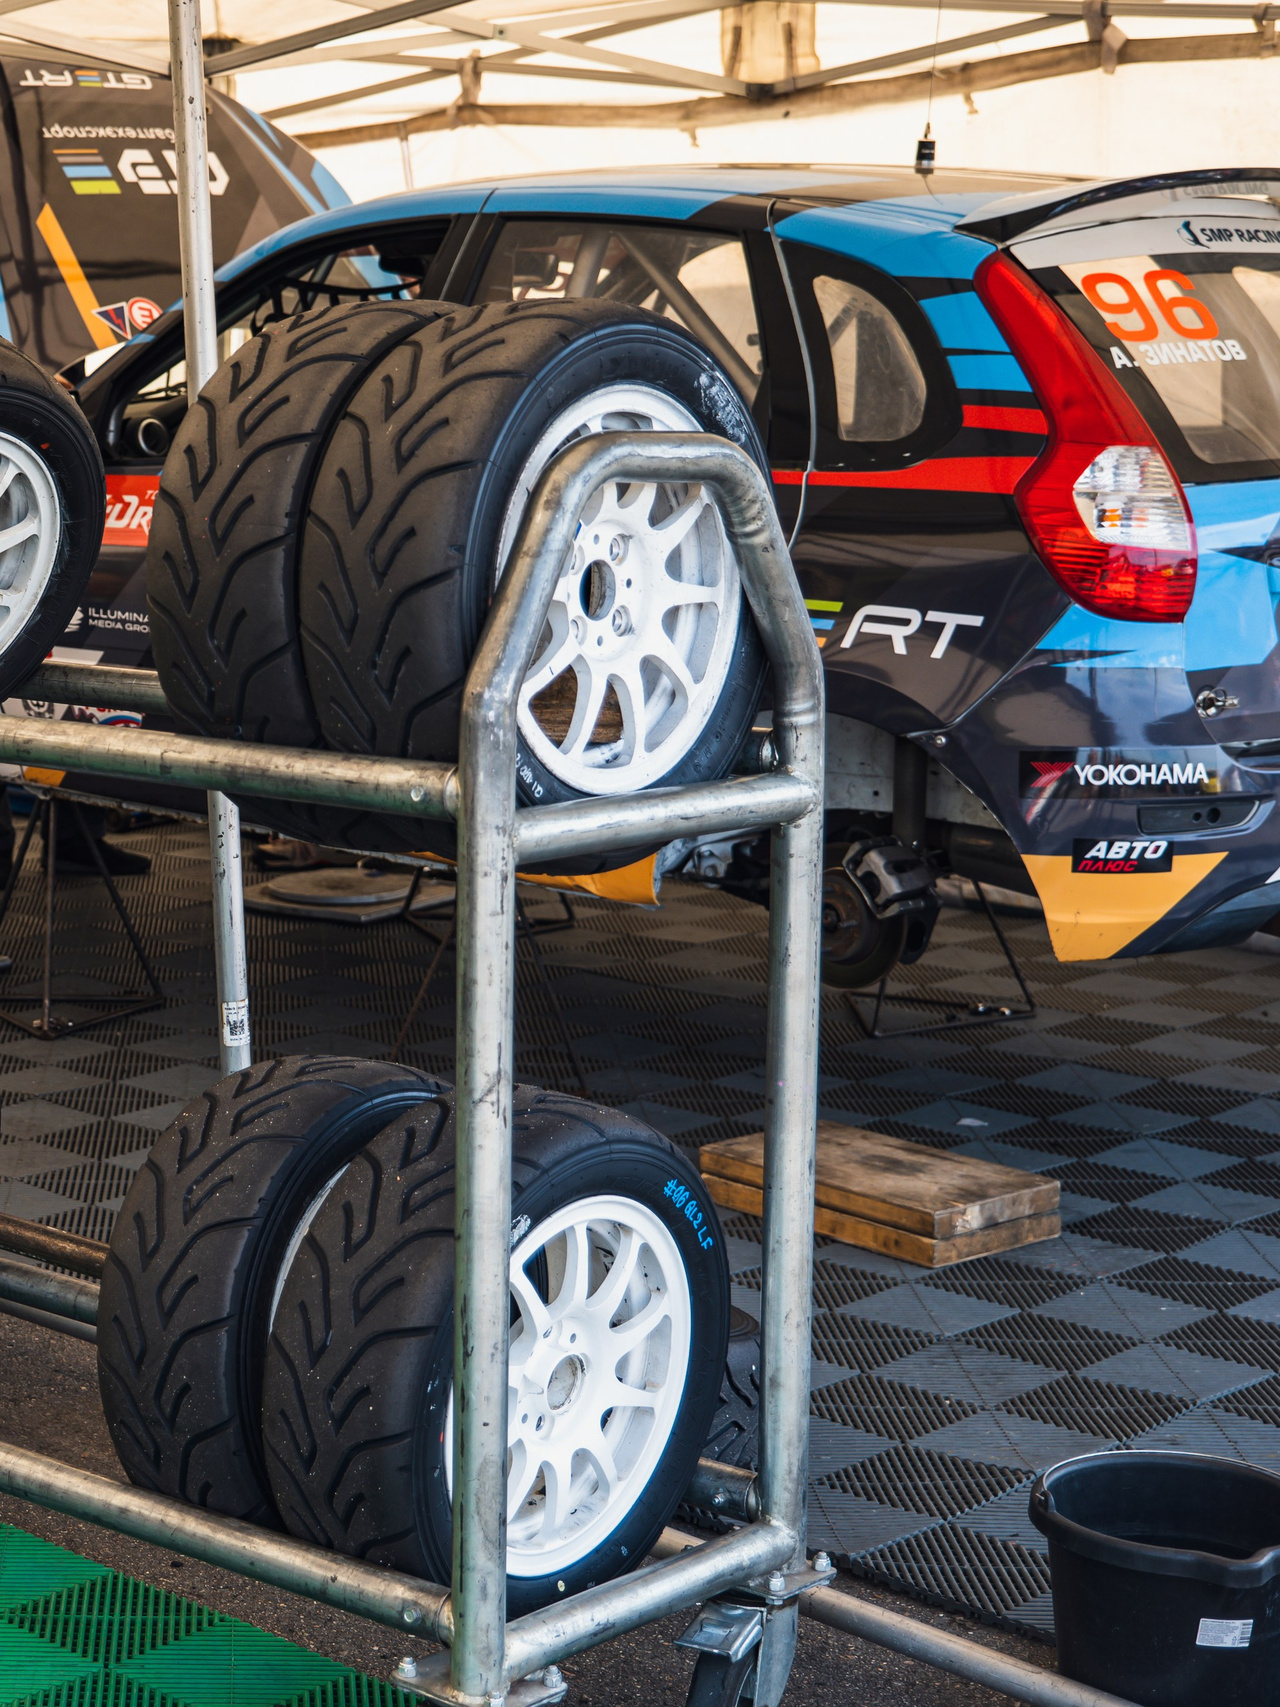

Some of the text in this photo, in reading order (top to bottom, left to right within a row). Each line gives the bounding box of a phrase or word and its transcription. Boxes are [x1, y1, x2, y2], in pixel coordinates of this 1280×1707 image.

[42, 122, 176, 143] балтехэкспорт
[1200, 228, 1234, 243] SMP
[1080, 268, 1219, 342] 96
[1139, 339, 1247, 366] ЗИНАТОВ
[88, 618, 150, 633] MEDIA GRO
[1073, 762, 1209, 786] YOKOHAMA
[1084, 841, 1168, 859] АВТО
[1077, 860, 1138, 872] ПЛЮС
